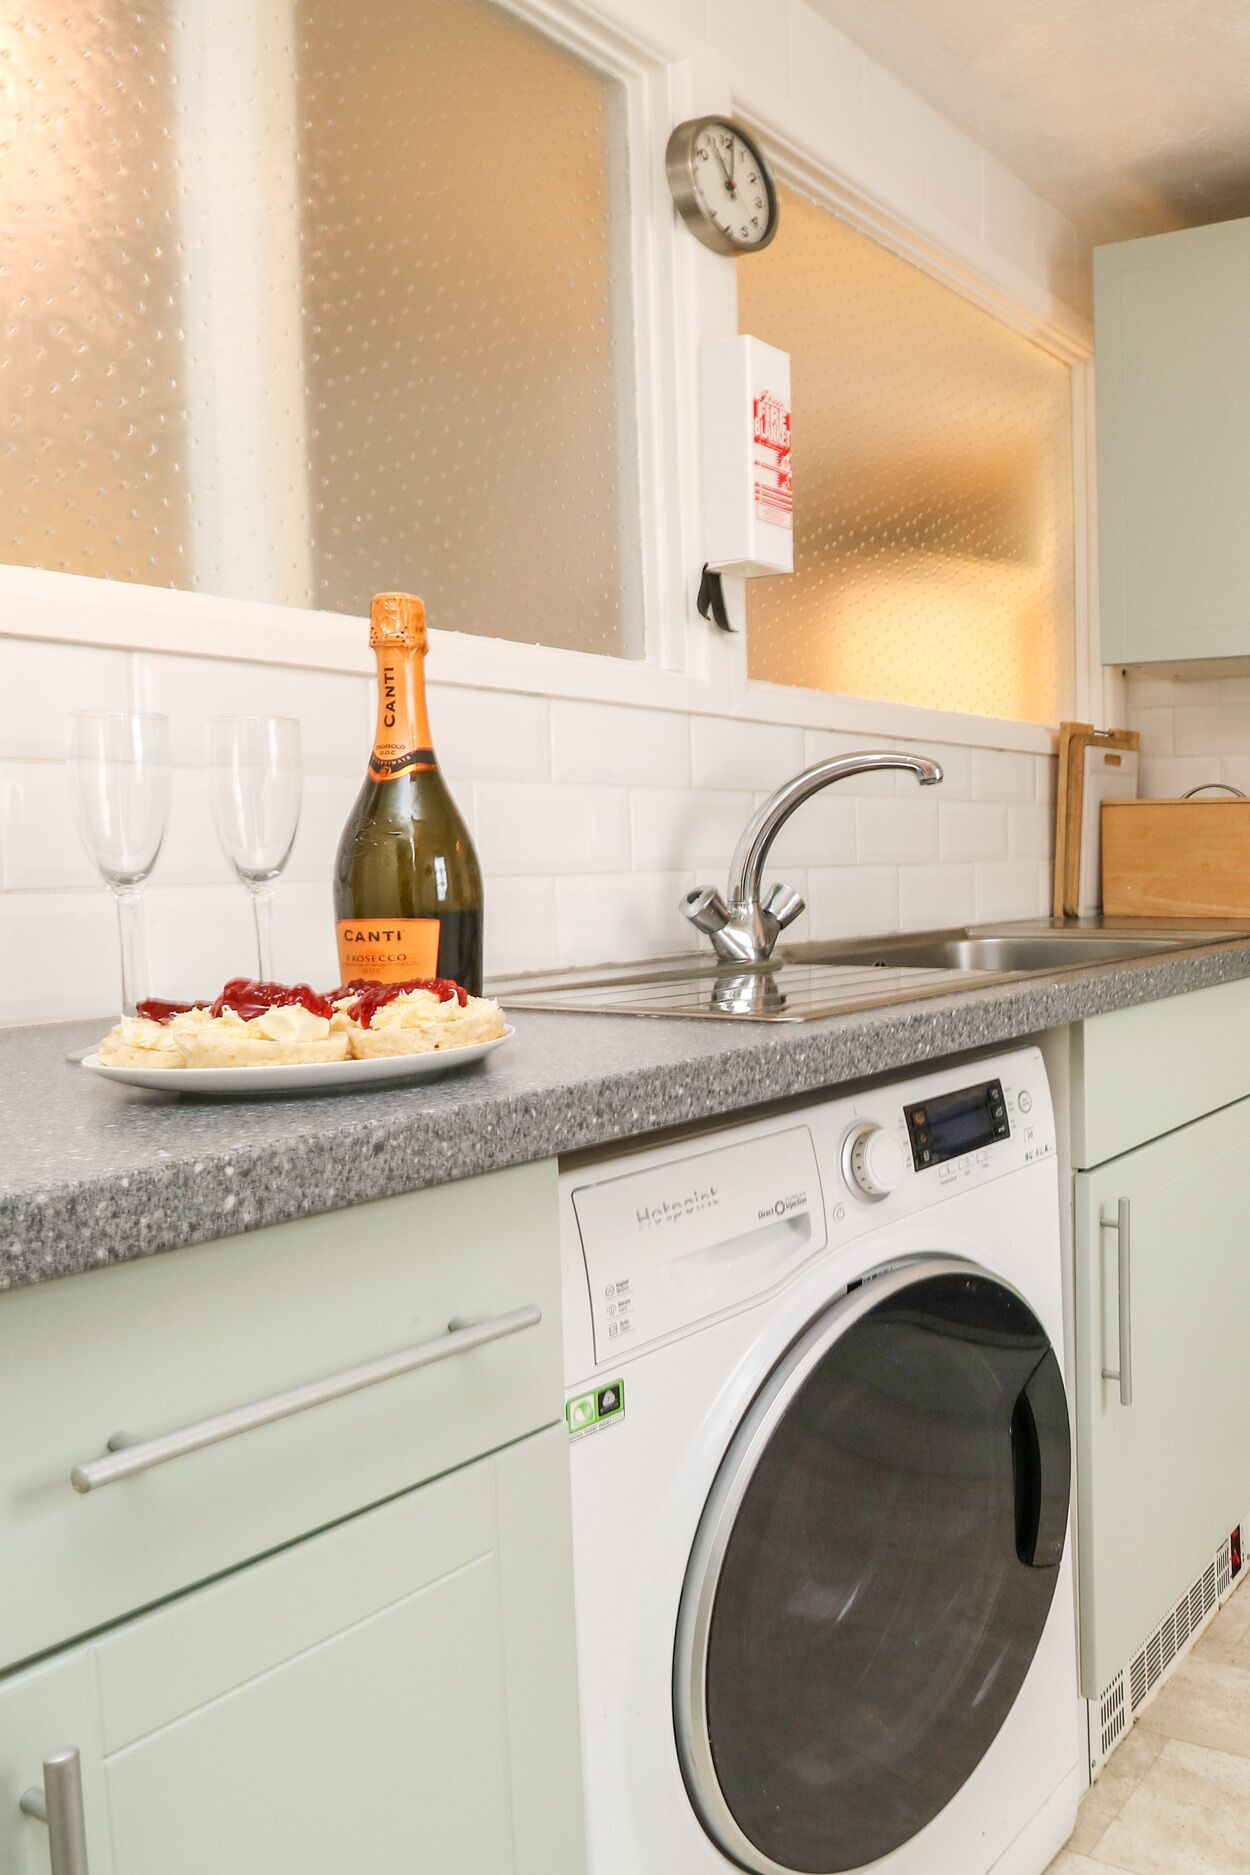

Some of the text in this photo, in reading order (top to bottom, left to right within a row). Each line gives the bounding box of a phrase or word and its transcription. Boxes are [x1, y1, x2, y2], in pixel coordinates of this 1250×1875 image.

[749, 172, 757, 185] 2
[741, 225, 749, 238] 5
[758, 400, 788, 431] FIRE
[754, 415, 791, 449] BLANKET
[383, 667, 396, 728] CANTI
[344, 929, 402, 943] CANTI
[346, 953, 407, 963] PROSECCO
[636, 1186, 720, 1228] Hotpoint
[757, 1208, 775, 1220] Direct
